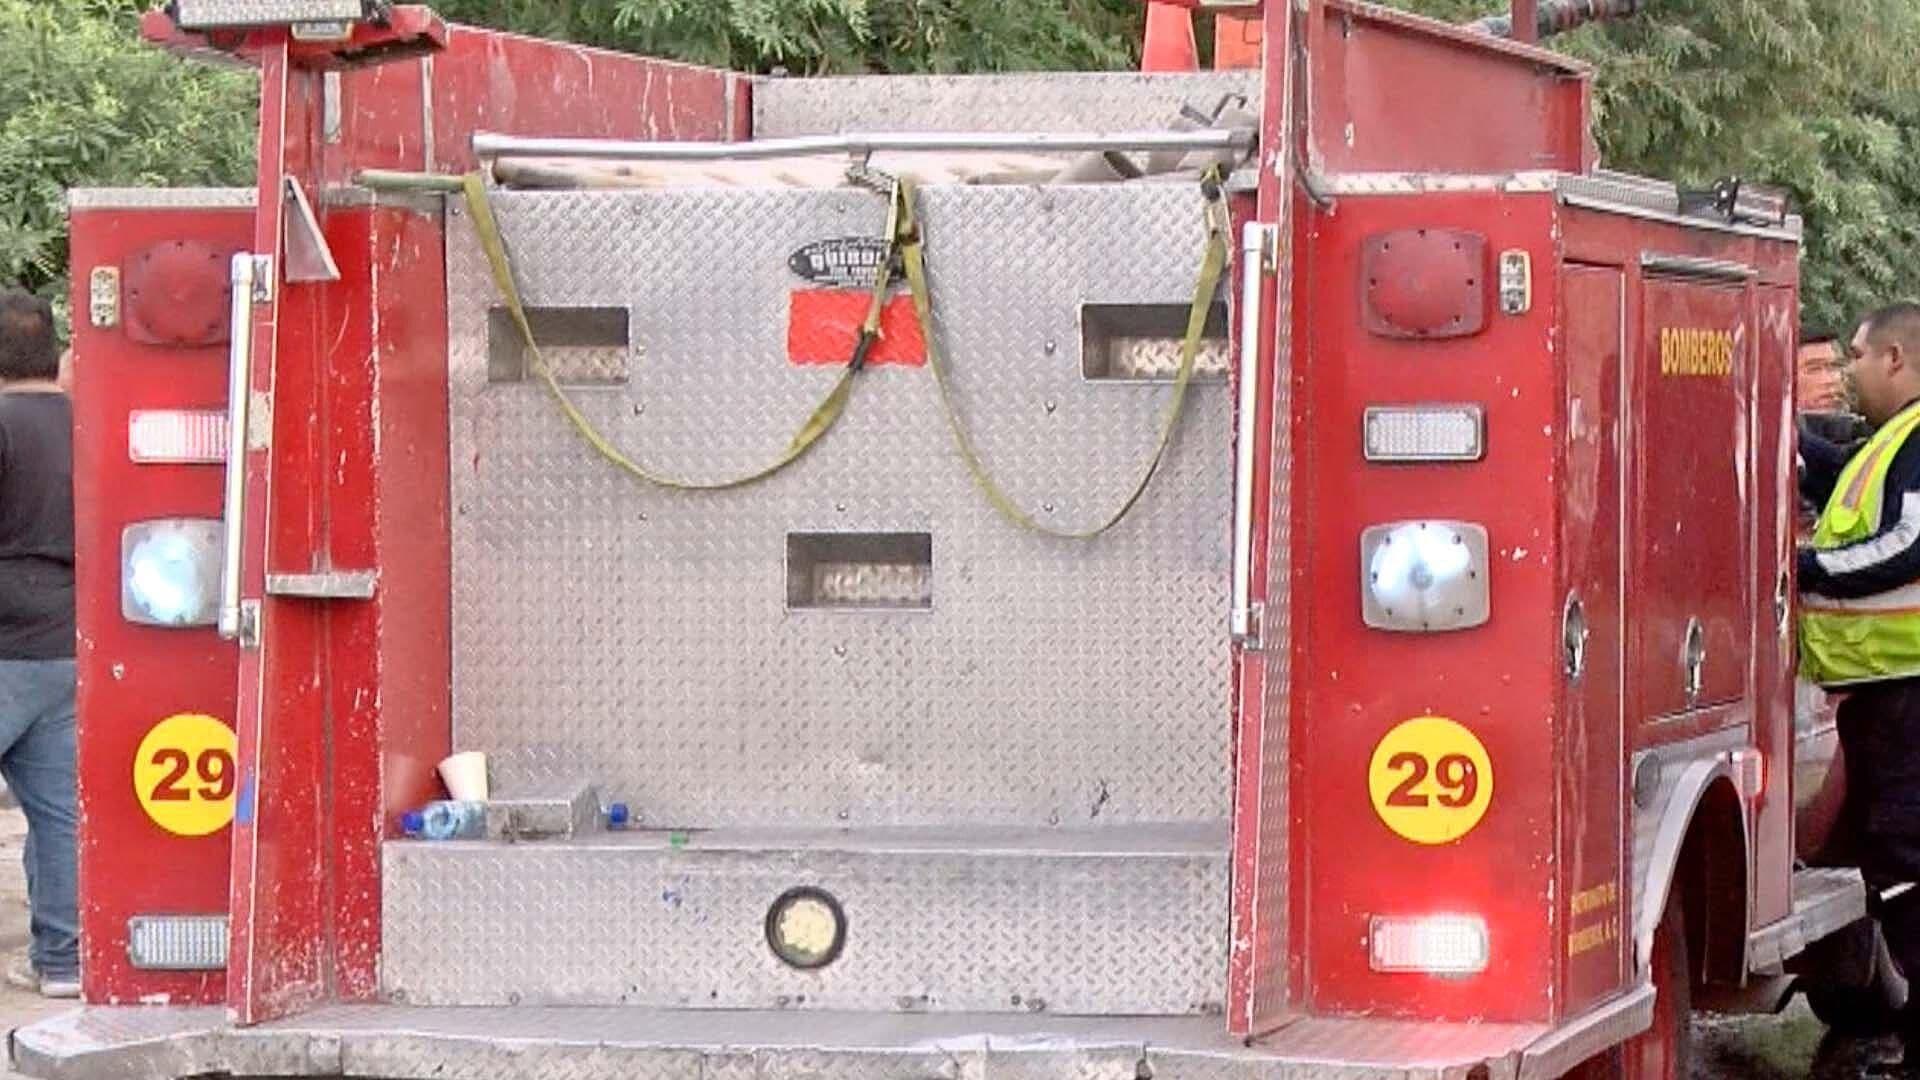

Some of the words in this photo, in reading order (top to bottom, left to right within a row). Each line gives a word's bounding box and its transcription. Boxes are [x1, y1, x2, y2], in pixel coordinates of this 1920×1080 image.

[1661, 327, 1733, 376] BOMBEROS
[150, 748, 235, 801] 29
[1385, 751, 1478, 807] 29
